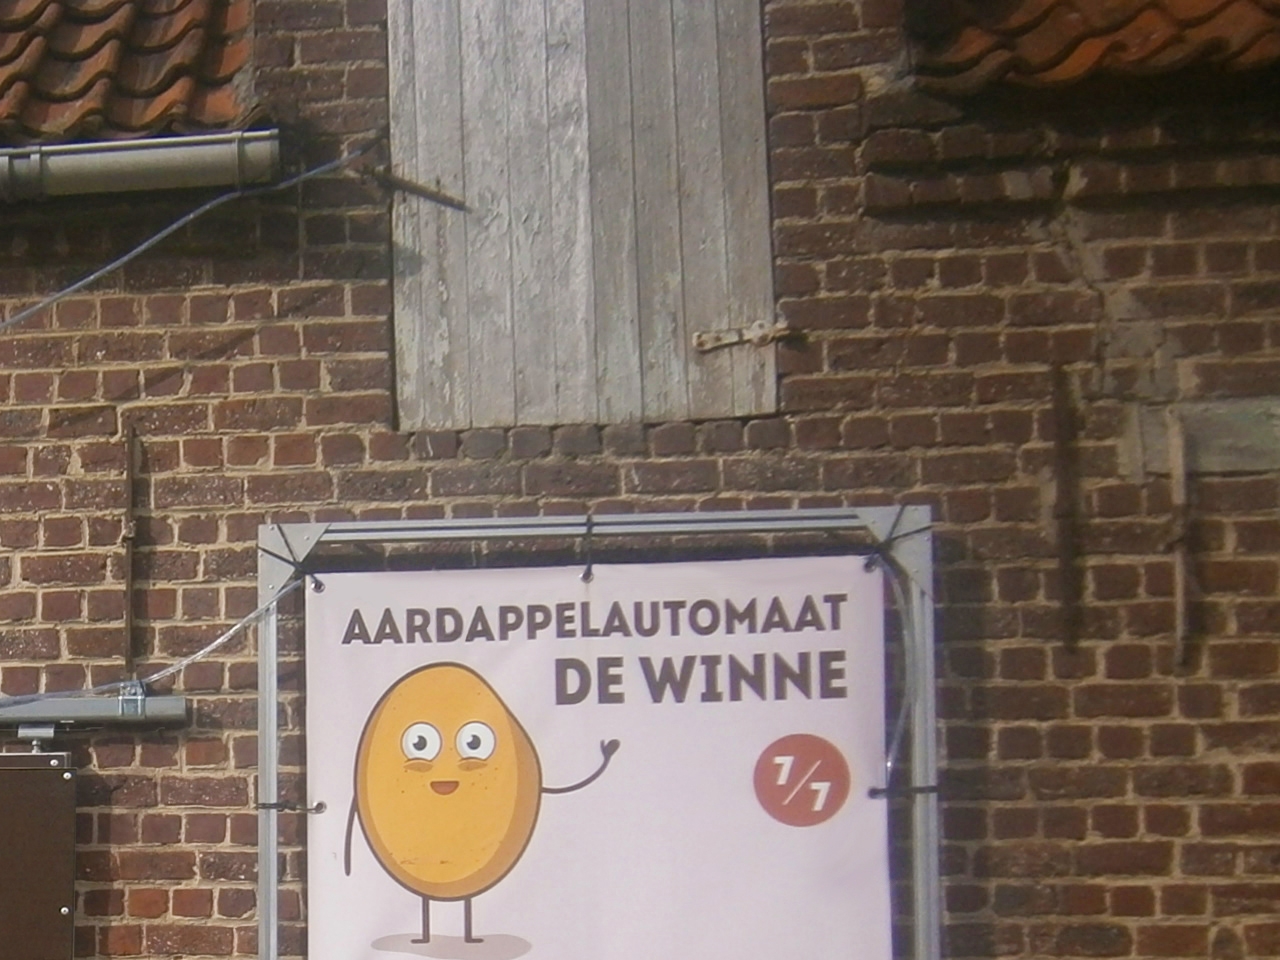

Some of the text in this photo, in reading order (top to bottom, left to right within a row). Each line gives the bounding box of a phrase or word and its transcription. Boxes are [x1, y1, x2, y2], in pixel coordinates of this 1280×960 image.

[341, 594, 848, 645] AARDAPPELAUTOMAAT
[554, 650, 848, 705] DE WINNE
[773, 755, 831, 812] 7/7
